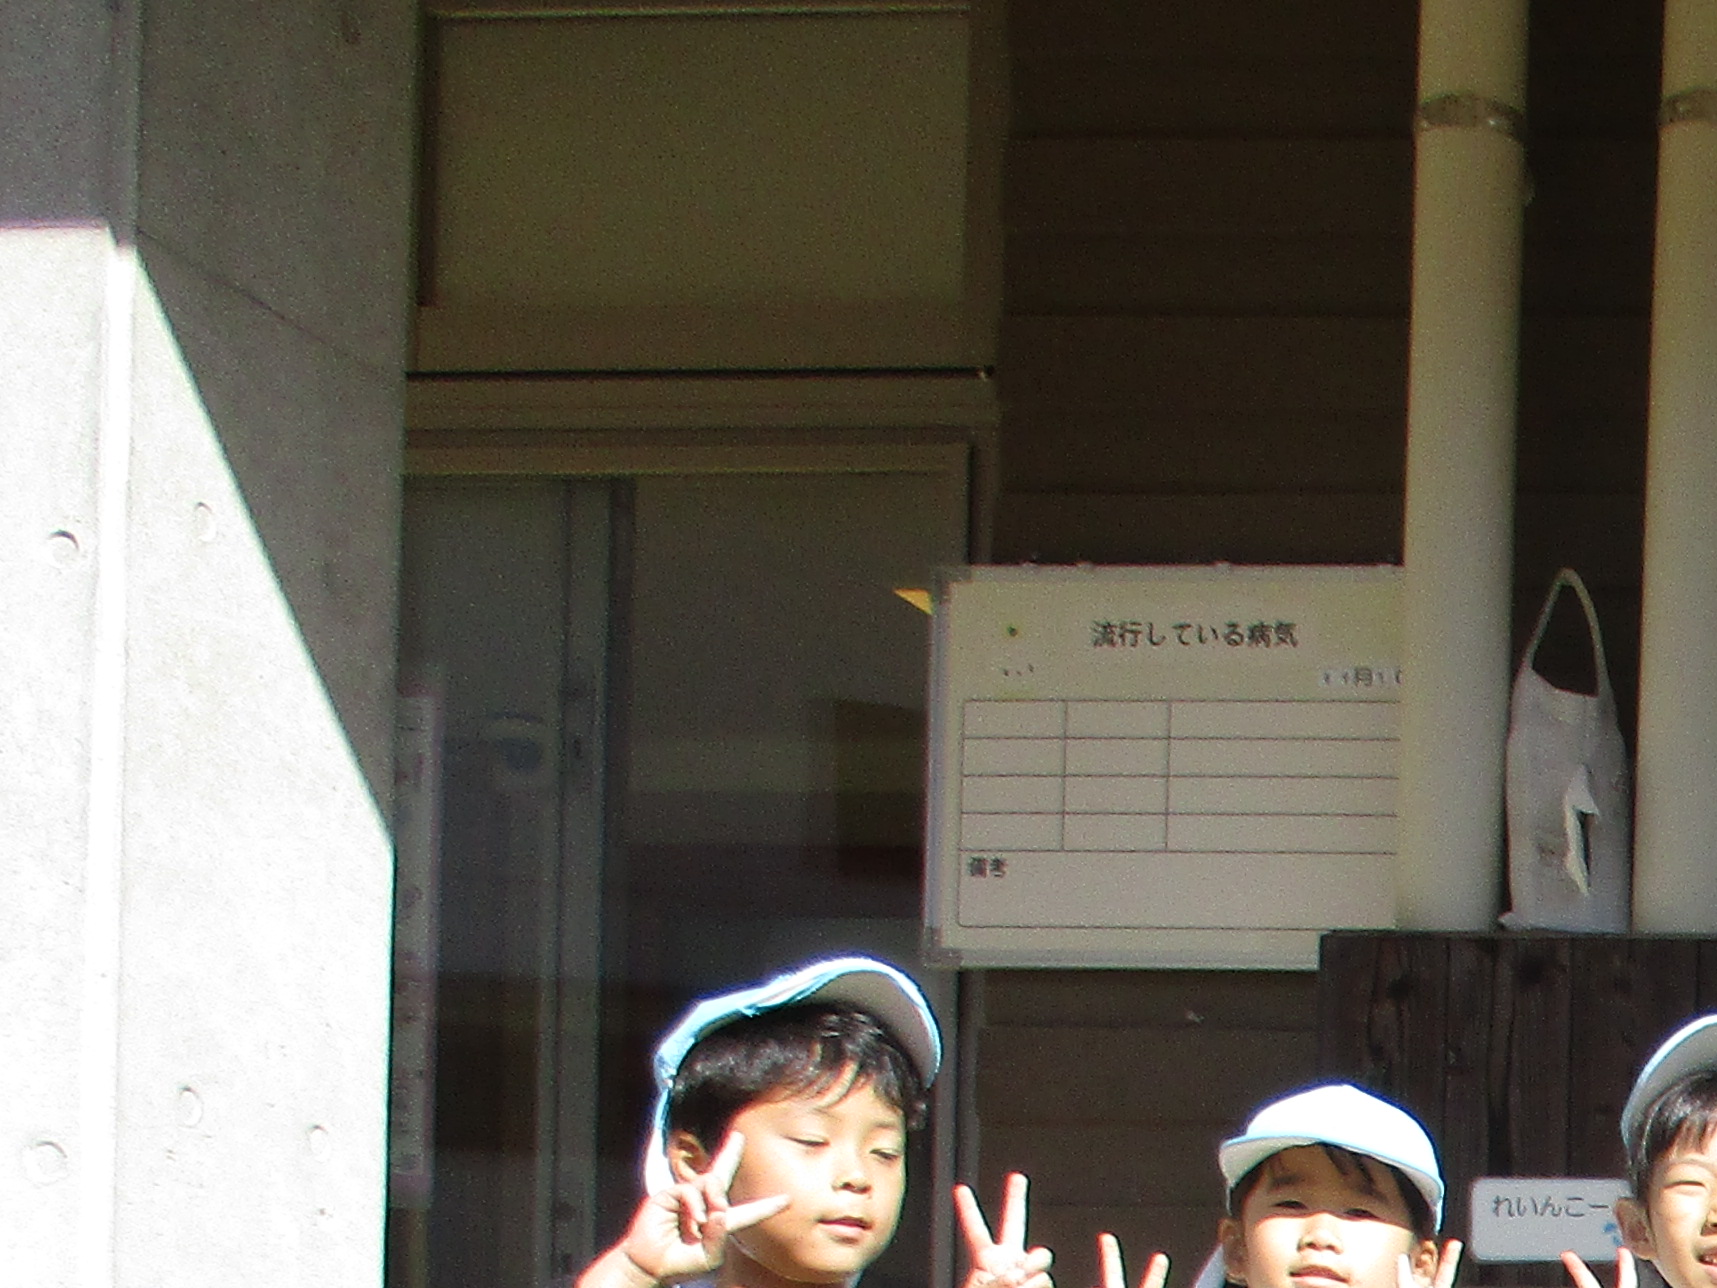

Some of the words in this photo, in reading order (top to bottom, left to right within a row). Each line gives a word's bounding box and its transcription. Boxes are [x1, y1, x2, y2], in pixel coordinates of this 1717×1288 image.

[1090, 620, 1299, 648] 流行している病気
